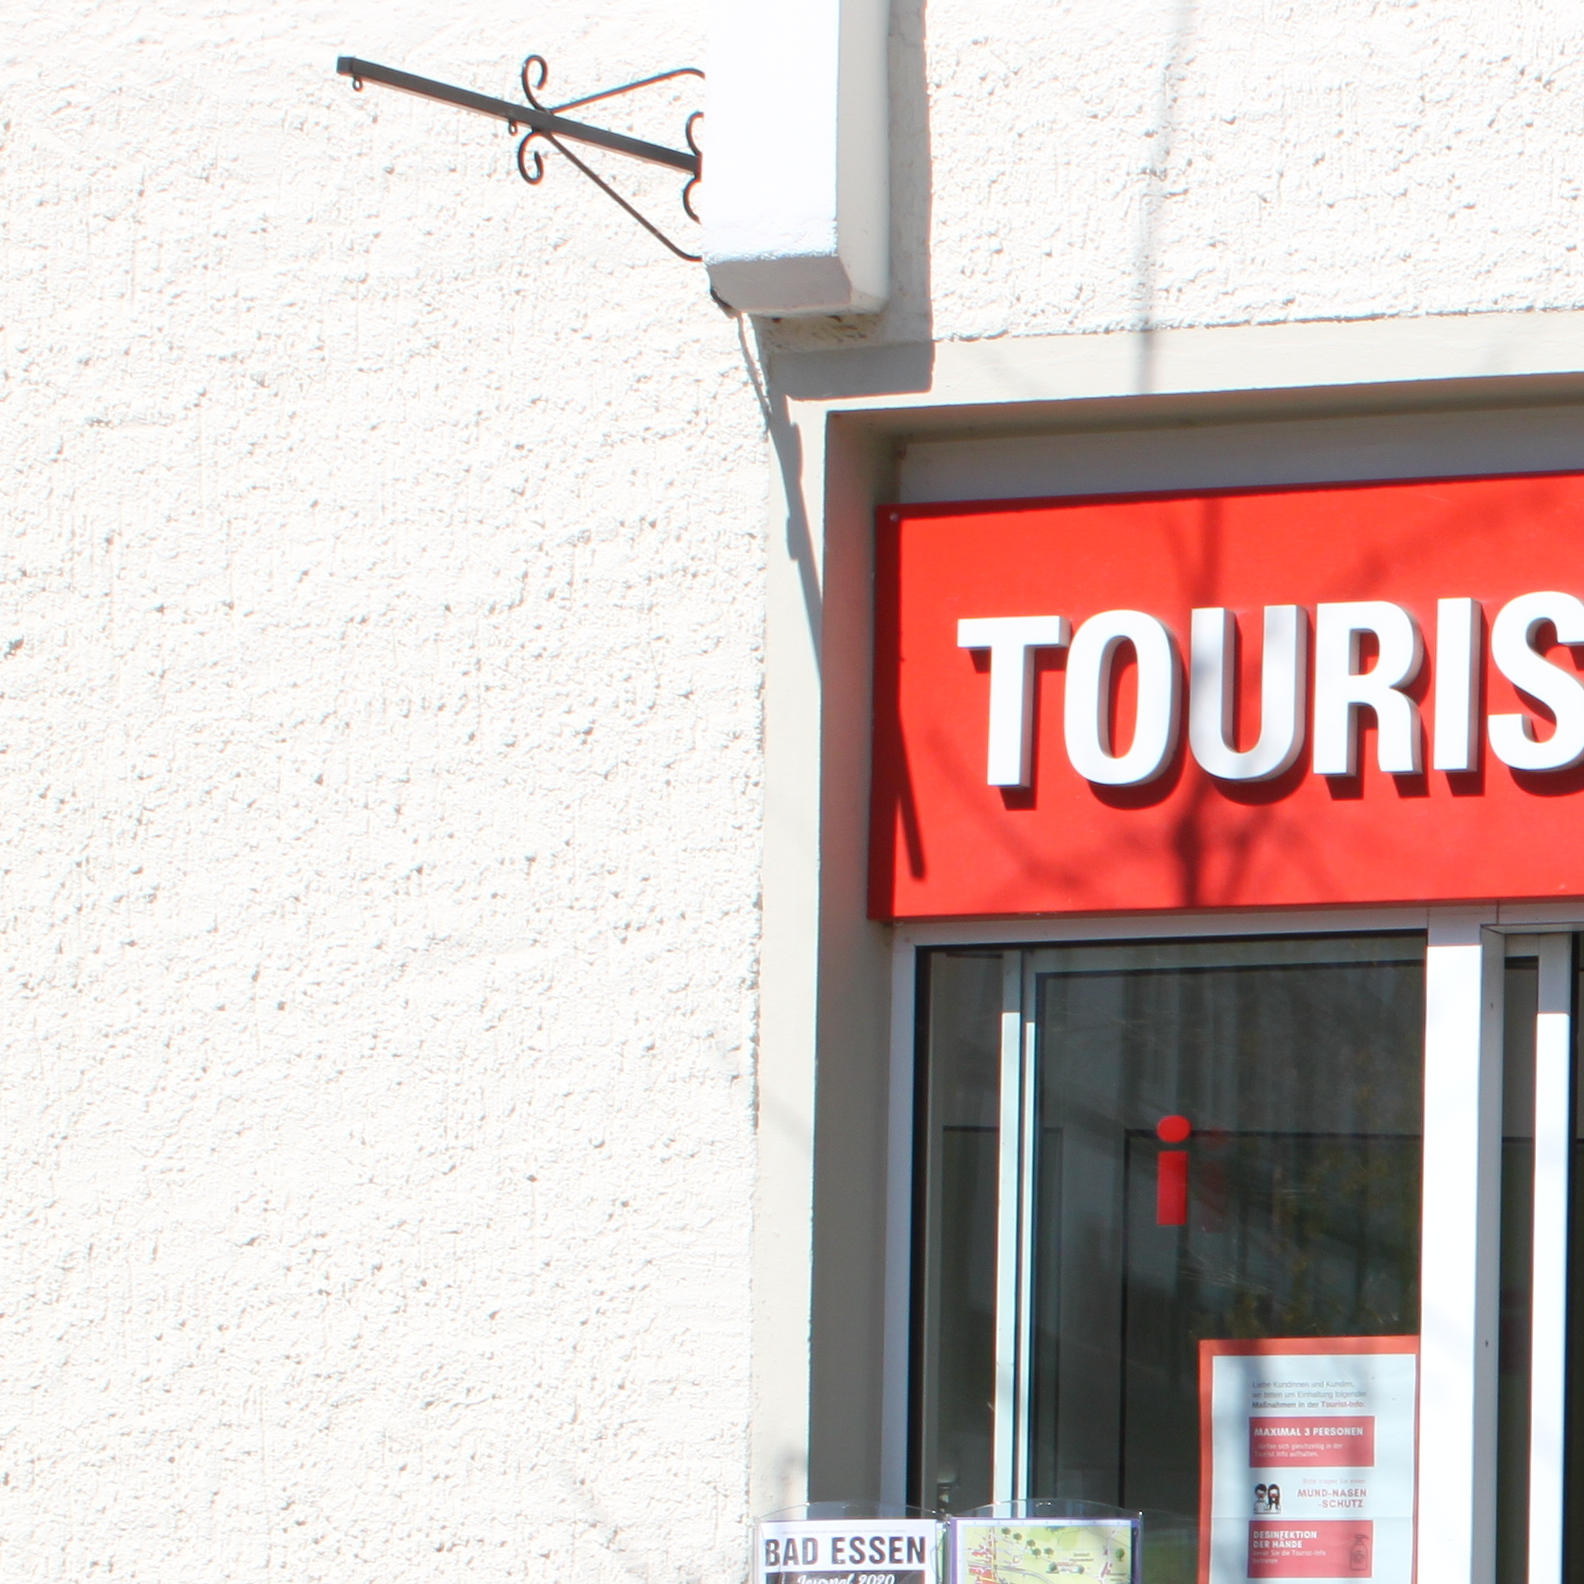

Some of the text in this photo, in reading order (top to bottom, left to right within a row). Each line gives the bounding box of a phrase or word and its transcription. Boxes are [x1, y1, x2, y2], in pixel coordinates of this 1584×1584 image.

[1254, 1427, 1363, 1436] MAXIMAL 3 PERSONEN
[1297, 1489, 1367, 1497] MUND-NASEN
[1254, 1531, 1317, 1539] DESINFEKTION
[1272, 1539, 1302, 1548] HÄNDE
[765, 1537, 926, 1566] BAD ESSEN
